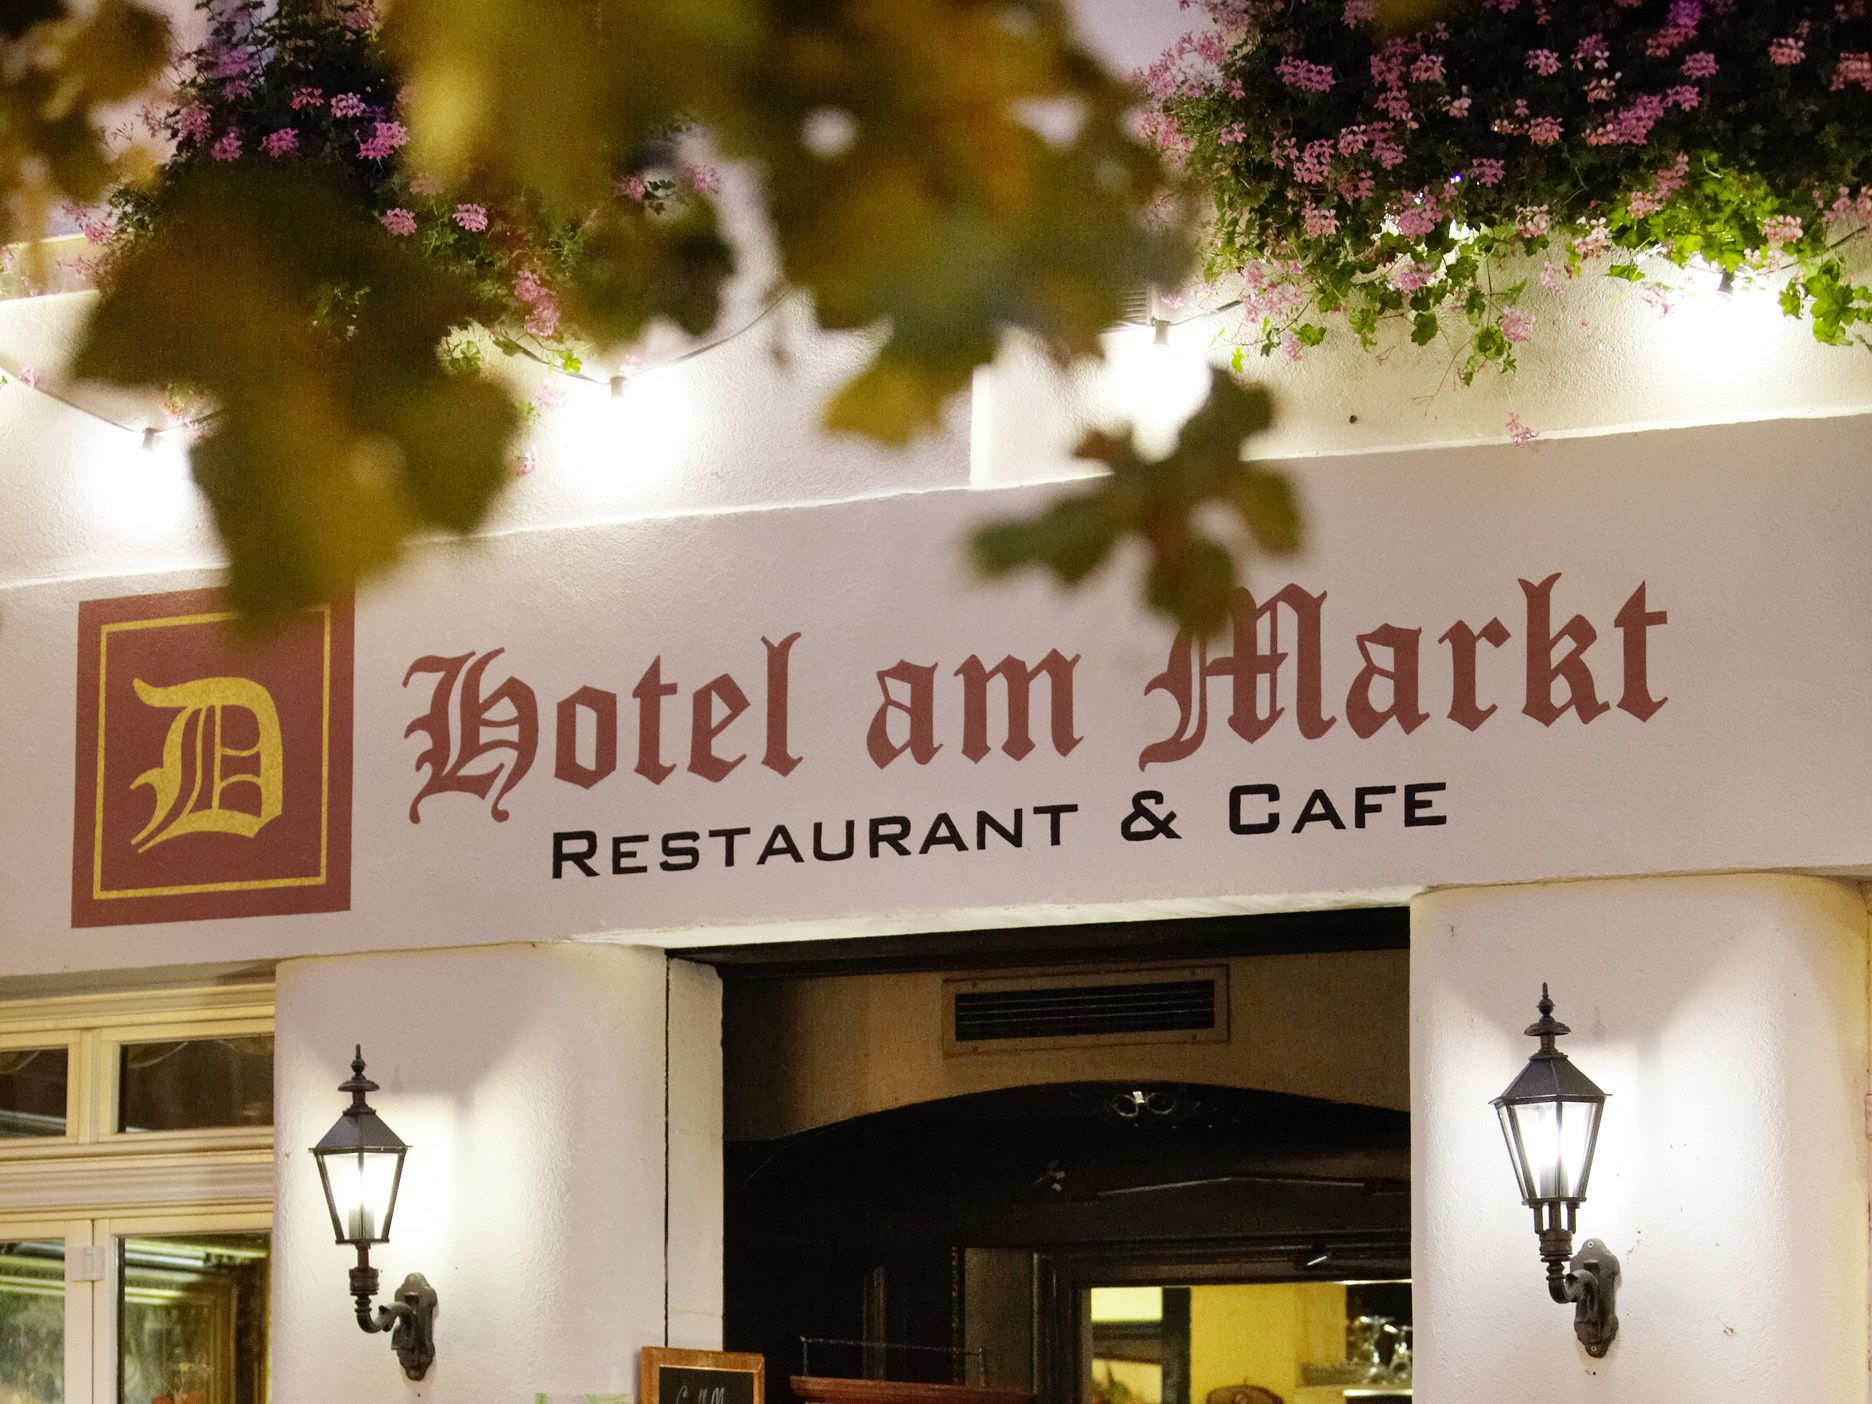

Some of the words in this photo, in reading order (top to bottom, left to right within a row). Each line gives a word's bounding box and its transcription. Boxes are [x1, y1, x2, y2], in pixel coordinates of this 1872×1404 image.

[402, 631, 803, 824] Hotel
[866, 648, 1084, 769] am
[1139, 571, 1668, 772] Markt
[552, 804, 1078, 880] RESTAURANT
[1121, 790, 1182, 841] &
[1229, 781, 1447, 835] CAFE
